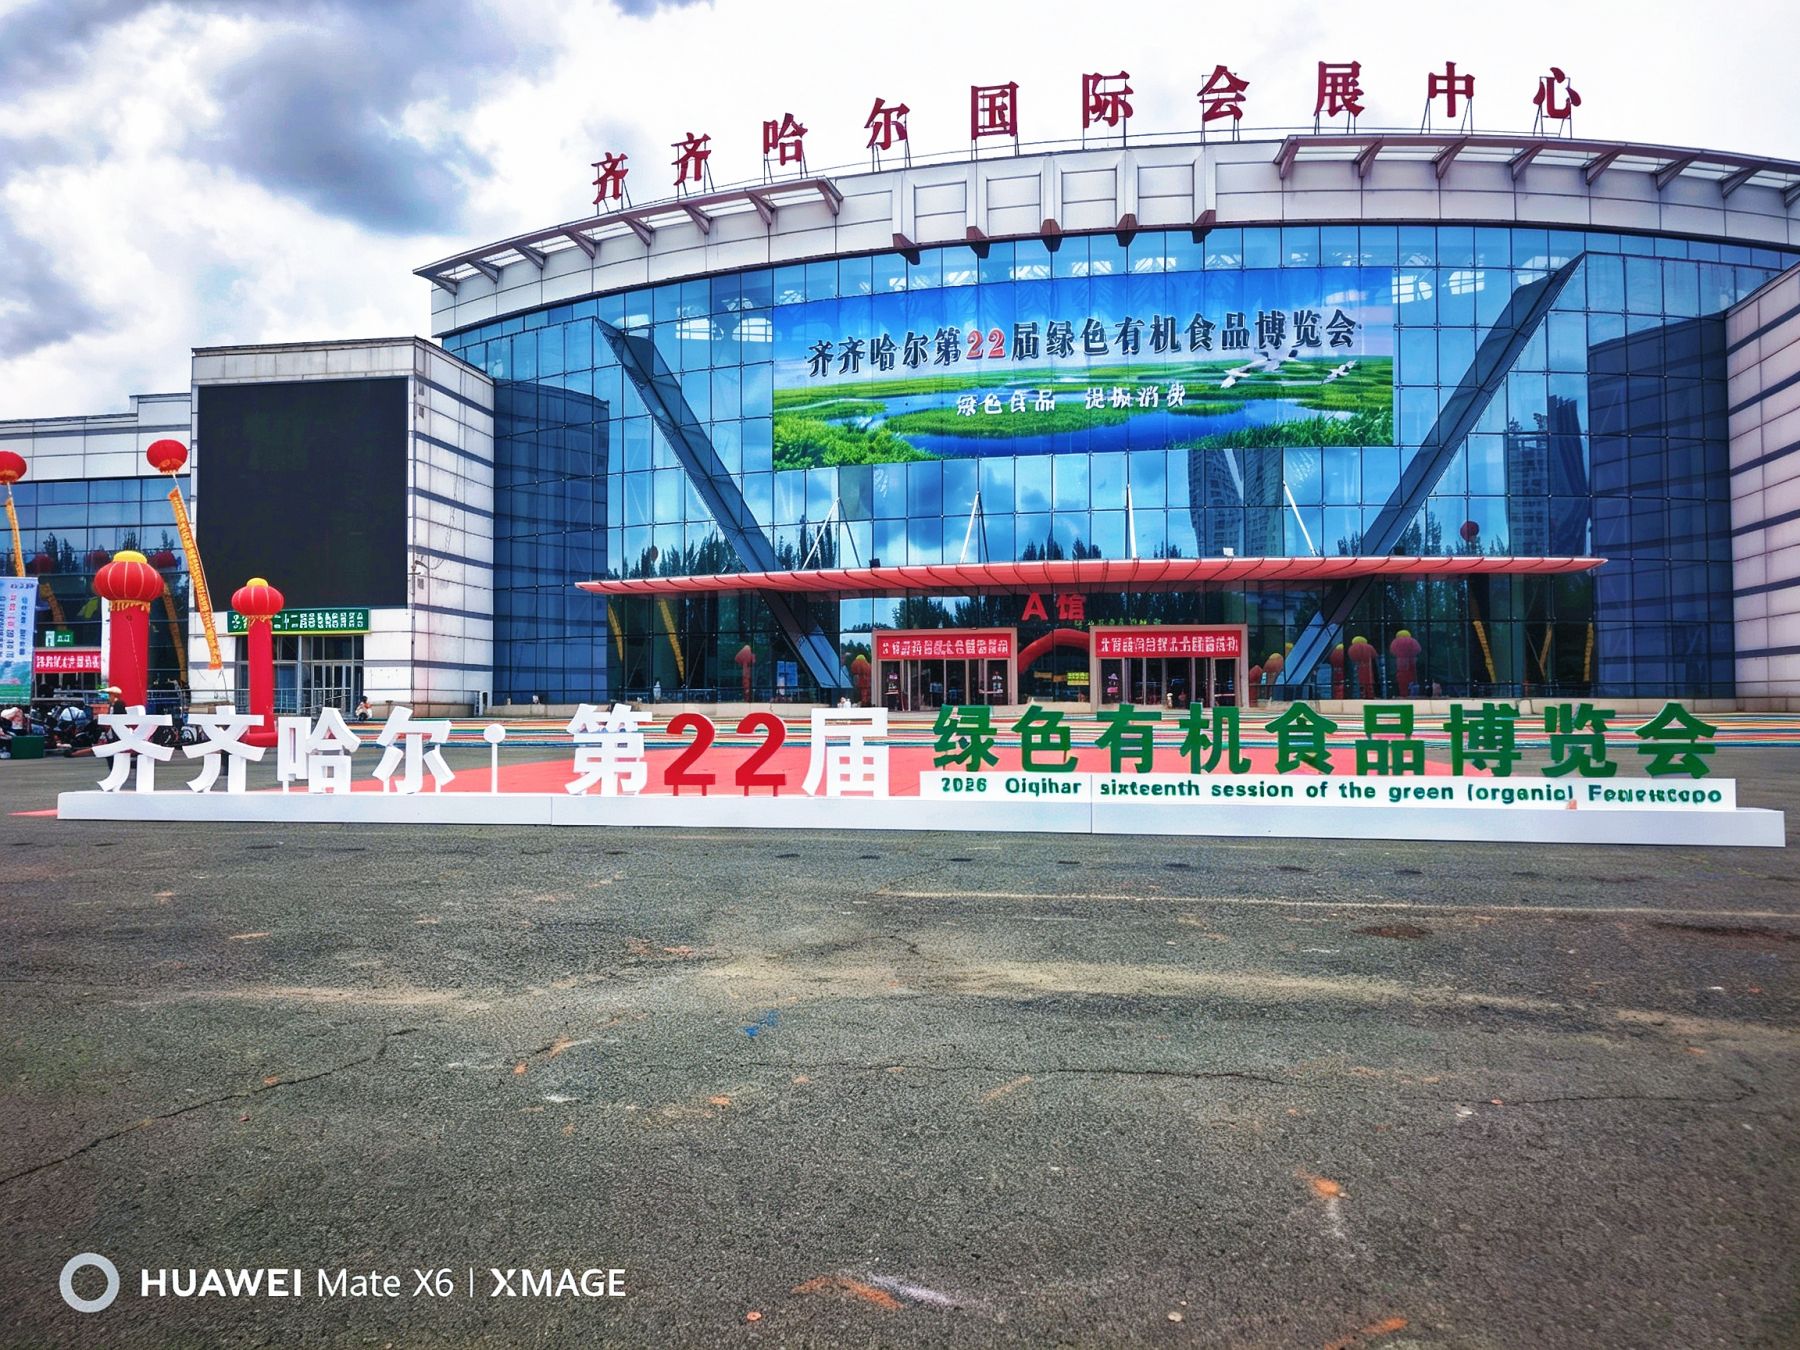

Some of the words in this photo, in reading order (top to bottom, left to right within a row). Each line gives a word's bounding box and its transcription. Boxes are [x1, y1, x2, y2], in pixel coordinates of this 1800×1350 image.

[591, 60, 1582, 205] 齐齐哈尔国际会展中心
[807, 308, 1358, 378] 齐齐哈尔第22届绿色有机食品博览会
[1100, 779, 1201, 797] sixteenth
[1211, 780, 1294, 797] session
[1306, 780, 1329, 798] of
[1339, 782, 1376, 799] the
[1388, 784, 1454, 803] green
